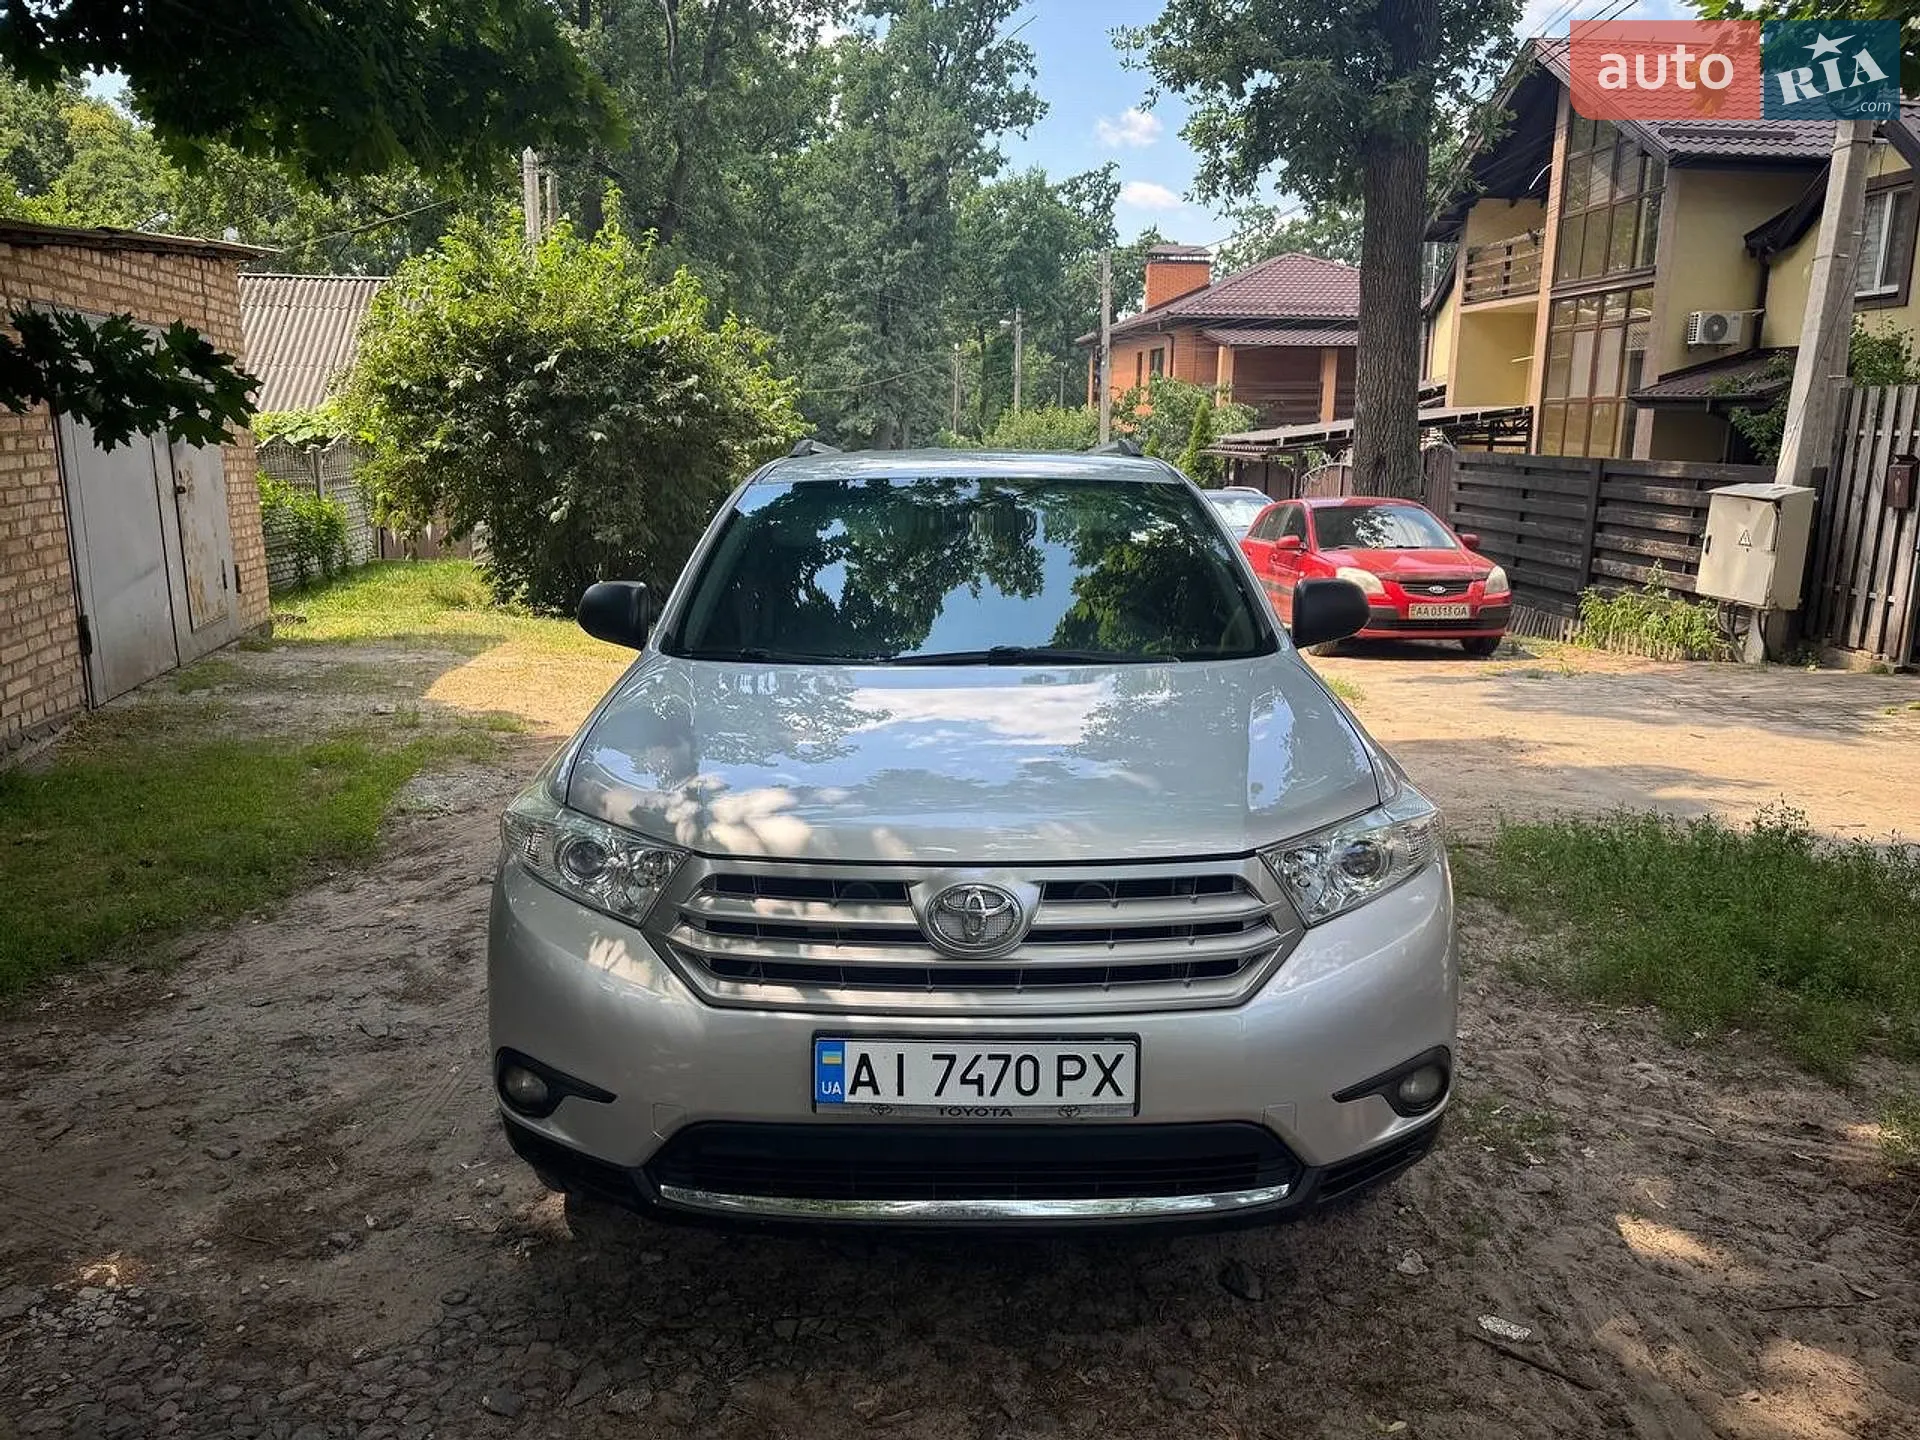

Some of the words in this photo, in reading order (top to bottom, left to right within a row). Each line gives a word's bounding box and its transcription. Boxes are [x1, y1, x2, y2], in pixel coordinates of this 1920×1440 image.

[848, 1053, 905, 1096] AI
[931, 1053, 1040, 1097] 7470
[1056, 1053, 1125, 1098] PX
[821, 1081, 842, 1096] UA
[939, 1105, 1013, 1117] TOYOTA
